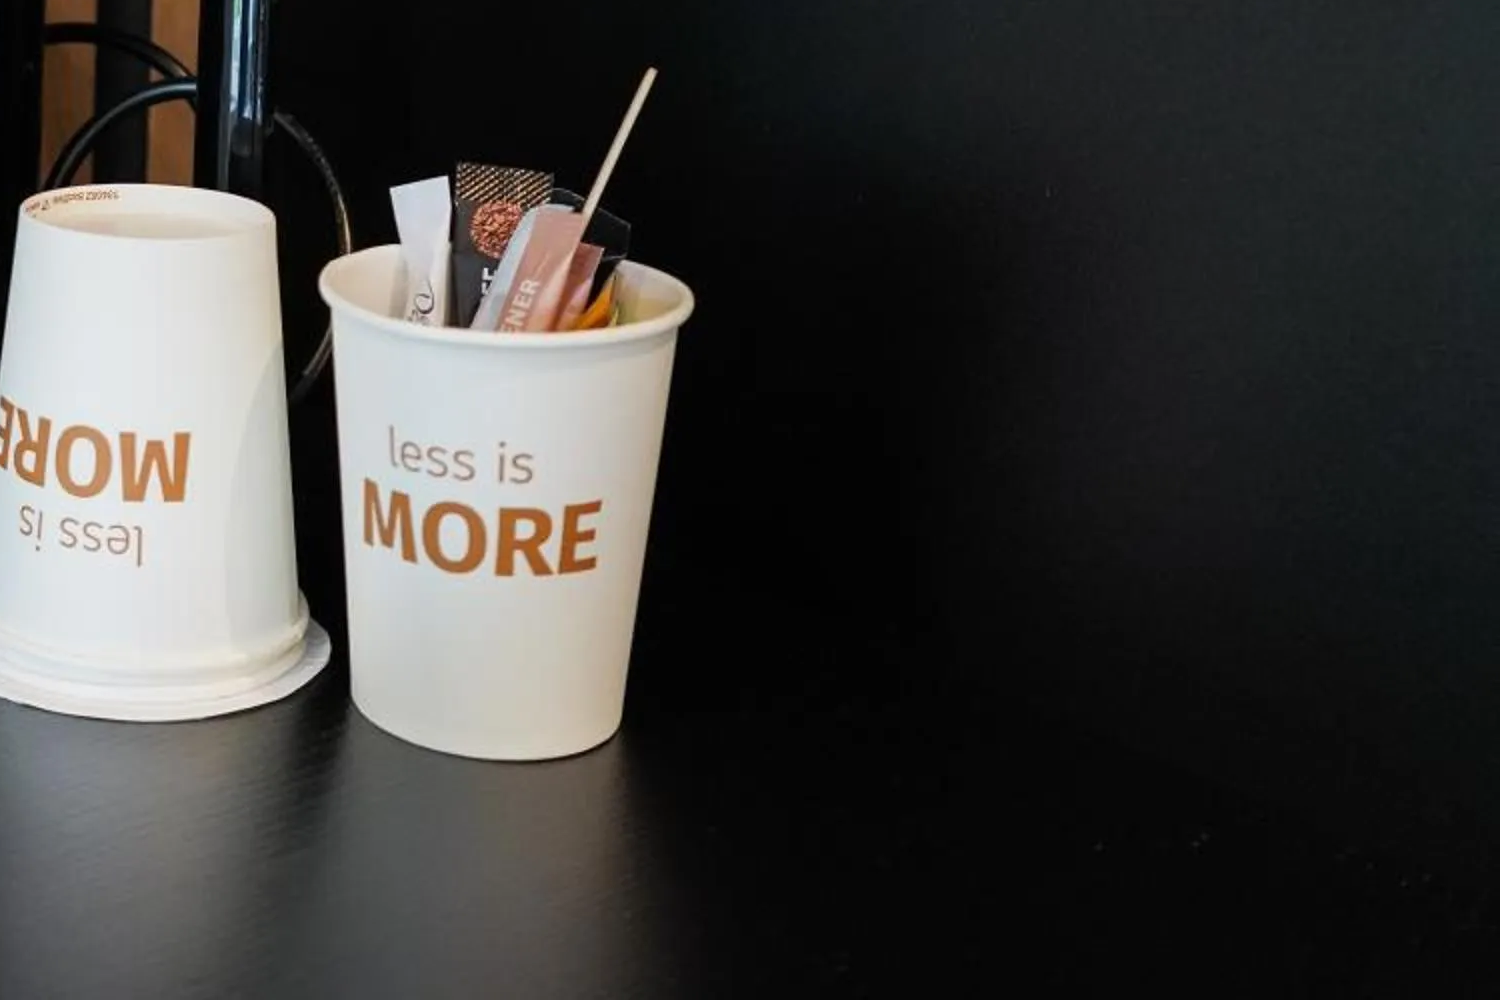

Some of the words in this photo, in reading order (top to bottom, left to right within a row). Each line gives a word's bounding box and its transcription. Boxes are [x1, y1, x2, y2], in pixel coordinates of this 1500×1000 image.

[388, 424, 476, 482] less
[497, 441, 534, 485] is
[18, 505, 43, 552] is
[59, 516, 145, 568] less
[363, 477, 603, 577] MORE
